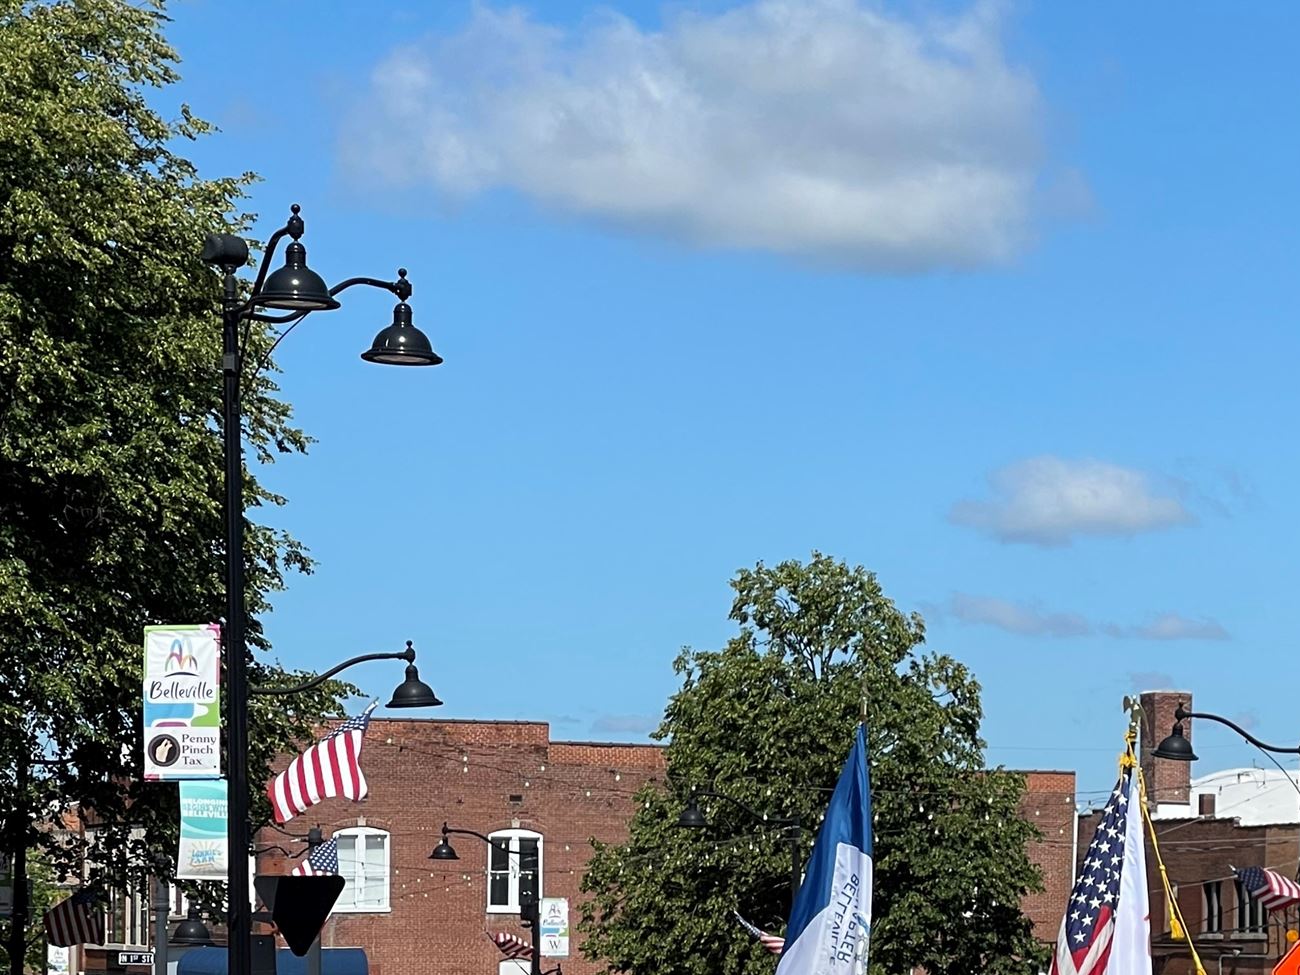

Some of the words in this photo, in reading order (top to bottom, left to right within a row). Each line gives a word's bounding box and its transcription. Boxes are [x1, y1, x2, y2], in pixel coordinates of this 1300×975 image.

[150, 680, 213, 700] Belleville
[182, 734, 217, 746] Penny
[182, 745, 213, 754] Pinch
[182, 756, 202, 765] Tax
[121, 955, 127, 963] N
